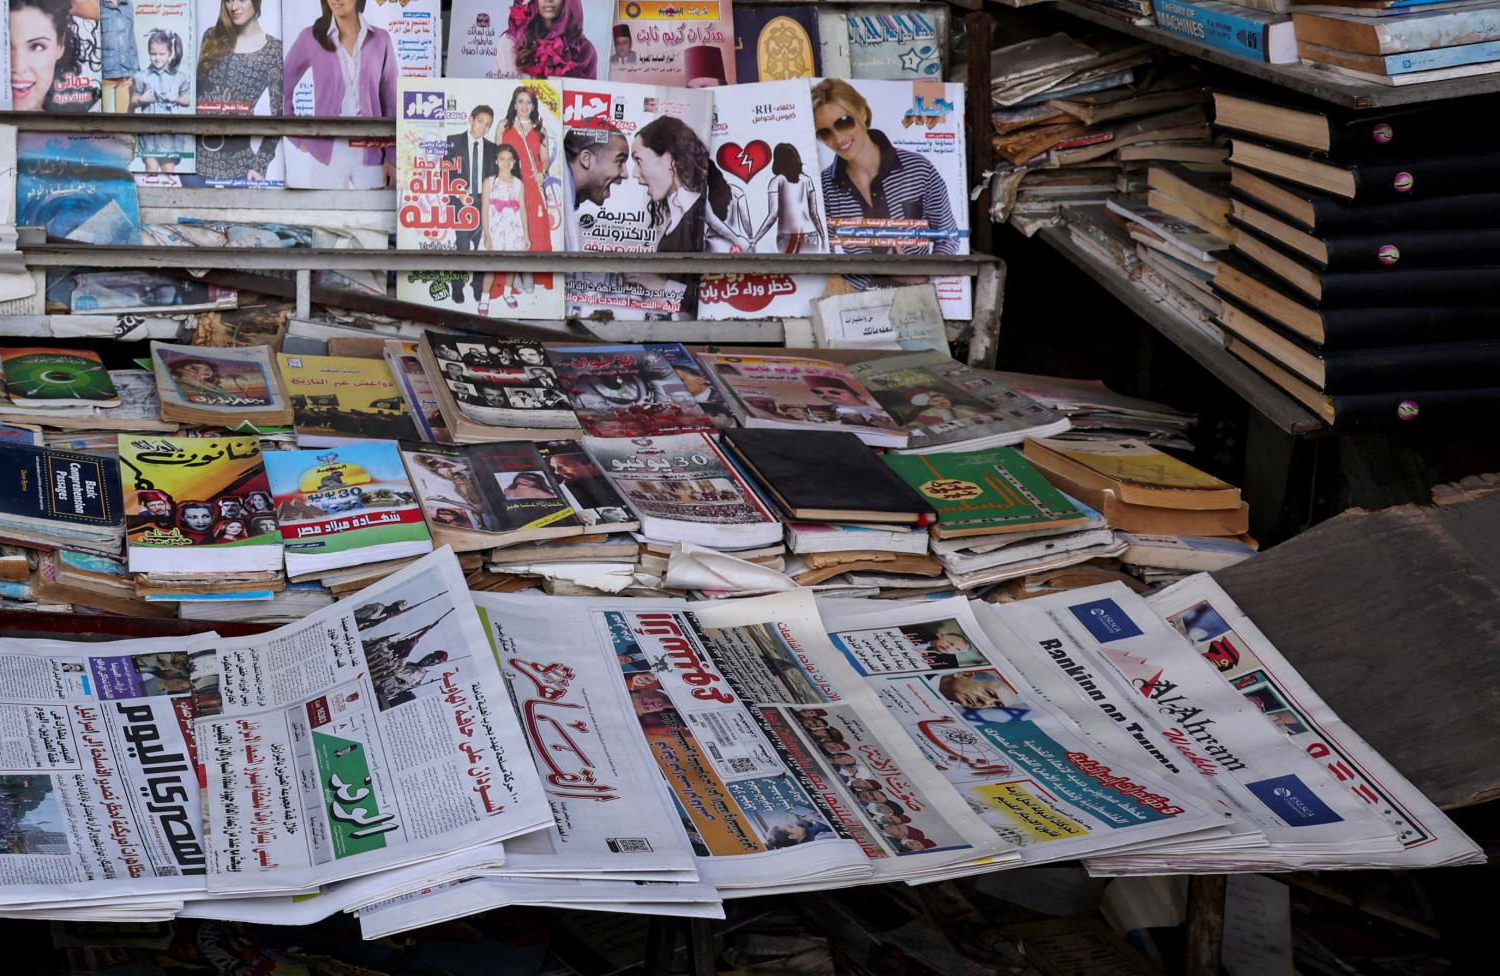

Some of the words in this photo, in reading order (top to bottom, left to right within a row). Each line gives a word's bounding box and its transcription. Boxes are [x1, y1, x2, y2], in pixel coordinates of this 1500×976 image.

[636, 24, 658, 43] ثابت
[663, 25, 687, 45] كريم
[690, 27, 724, 43] مذكرات
[1152, 11, 1206, 39] MACHINES
[409, 171, 468, 196] عائلة
[399, 195, 480, 238] فنية
[597, 209, 645, 226] الجريمة
[700, 286, 720, 301] باب
[721, 285, 740, 298] كل
[743, 284, 765, 296] وراء
[768, 281, 793, 293] خطر
[136, 443, 260, 467] فنانون
[611, 456, 673, 472] يونيو
[675, 455, 708, 466] 30
[54, 470, 68, 500] Passages
[67, 460, 87, 515] Comprehension
[83, 477, 99, 500] Basic
[339, 486, 363, 499] 30
[308, 491, 337, 503] يونيو
[297, 525, 323, 538] مصر
[323, 520, 350, 533] ميلاد
[353, 512, 402, 530] شهادة
[634, 613, 735, 705] الأسبوع
[434, 667, 467, 708] الهاوية
[471, 681, 484, 701] شاملة
[316, 706, 327, 724] 16383
[476, 698, 489, 716] أهلية
[73, 704, 100, 738] إسرائيل
[454, 704, 475, 737] حافة
[480, 717, 494, 736] بحرب
[508, 658, 621, 802] القاهرة
[1131, 670, 1248, 776] Al-Ahram
[82, 730, 104, 747] إلى
[116, 702, 188, 774] اليوم
[489, 736, 503, 752] تهدد
[458, 742, 483, 764] على
[495, 749, 507, 773] مسلحة
[1161, 727, 1218, 777] Weekly
[90, 748, 113, 782] الأسلحة
[94, 778, 120, 805] تصدير
[467, 766, 504, 817] السودان
[503, 771, 514, 792] حركة
[328, 769, 400, 839] الوفد
[139, 762, 205, 875] المصري
[107, 820, 139, 851] أمريكية
